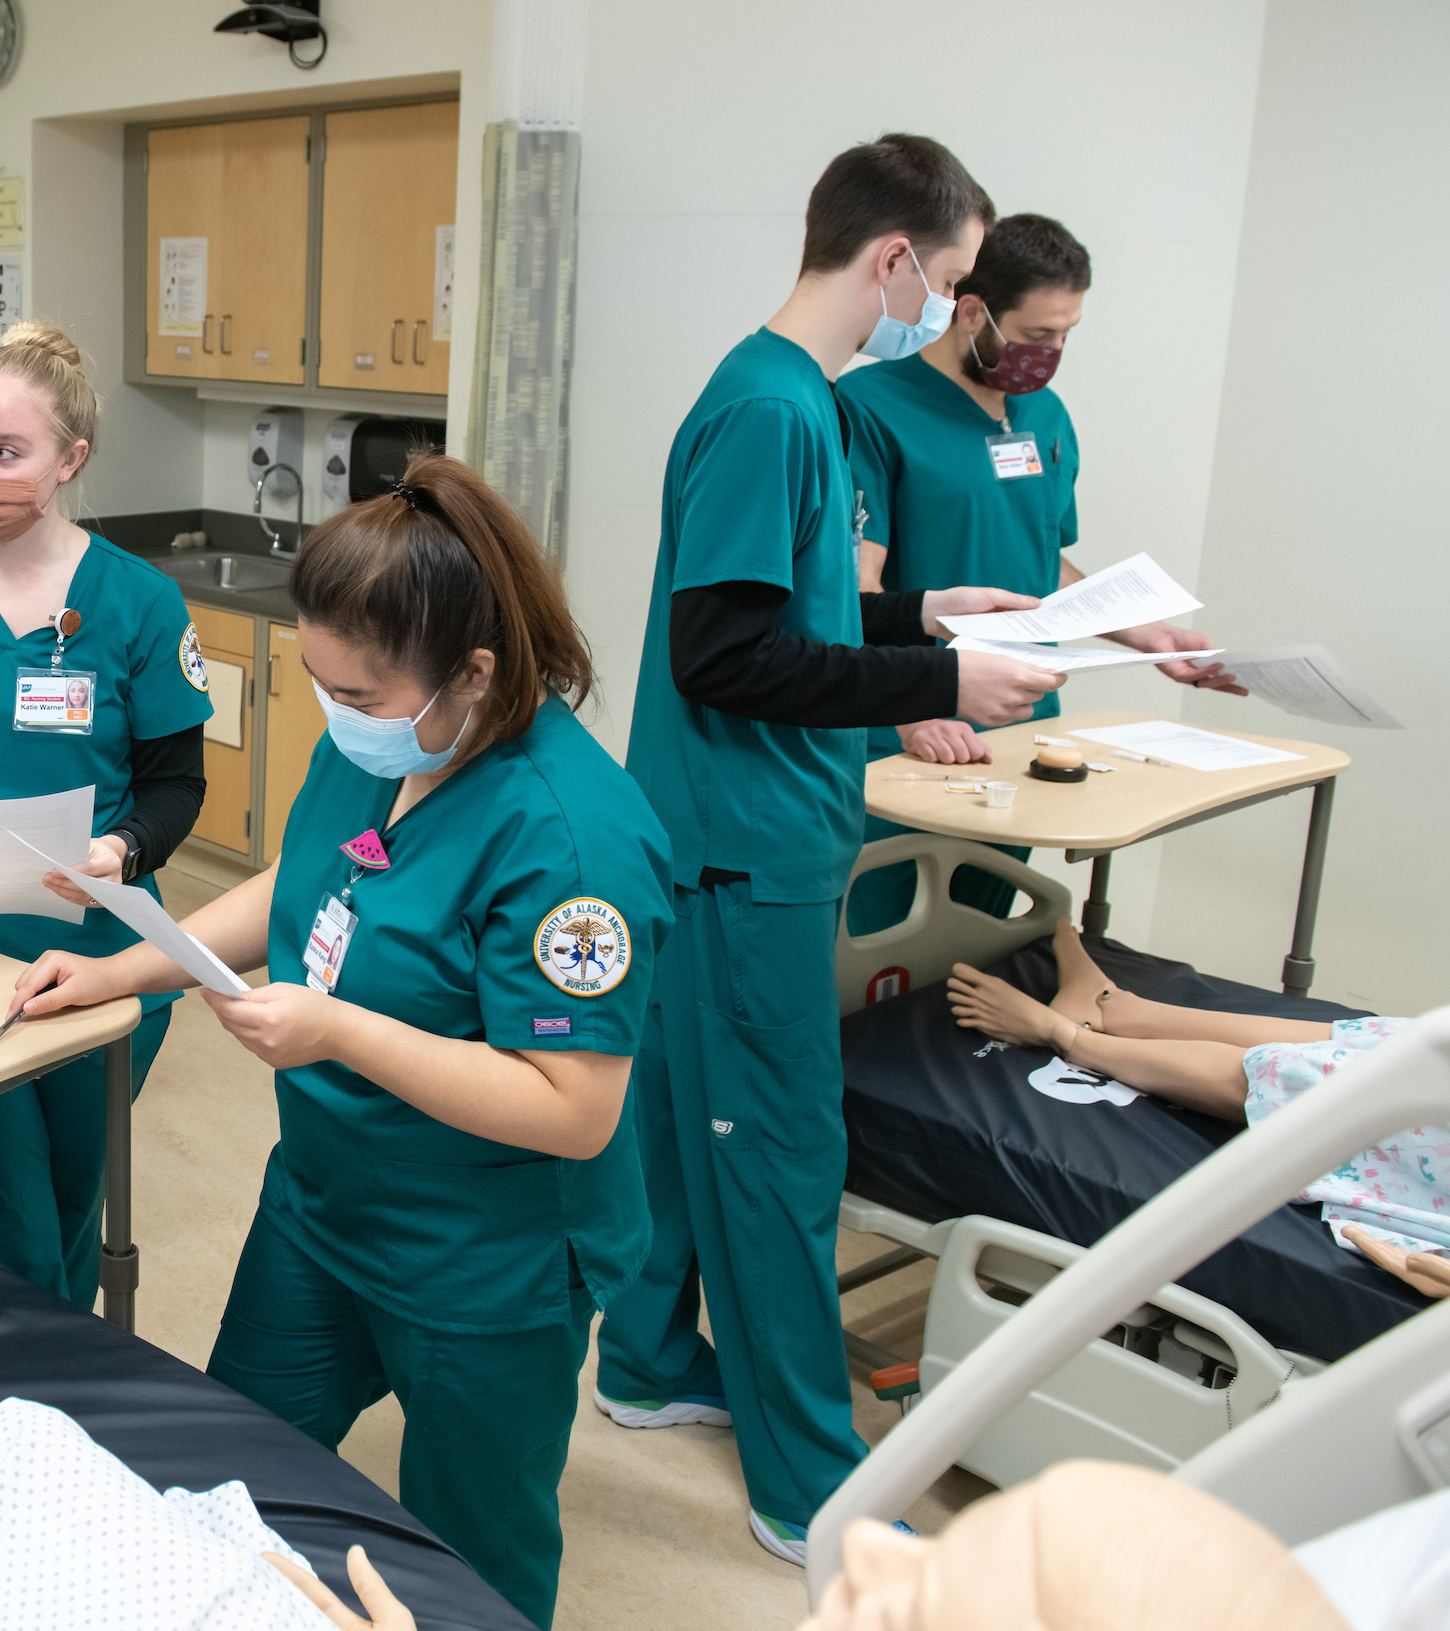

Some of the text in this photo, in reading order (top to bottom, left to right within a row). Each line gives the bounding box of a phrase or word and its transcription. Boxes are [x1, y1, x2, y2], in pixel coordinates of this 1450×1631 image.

[540, 904, 627, 966] UNIVERSITY OF ALASKA ANCHORAGE
[563, 978, 602, 992] NURSING
